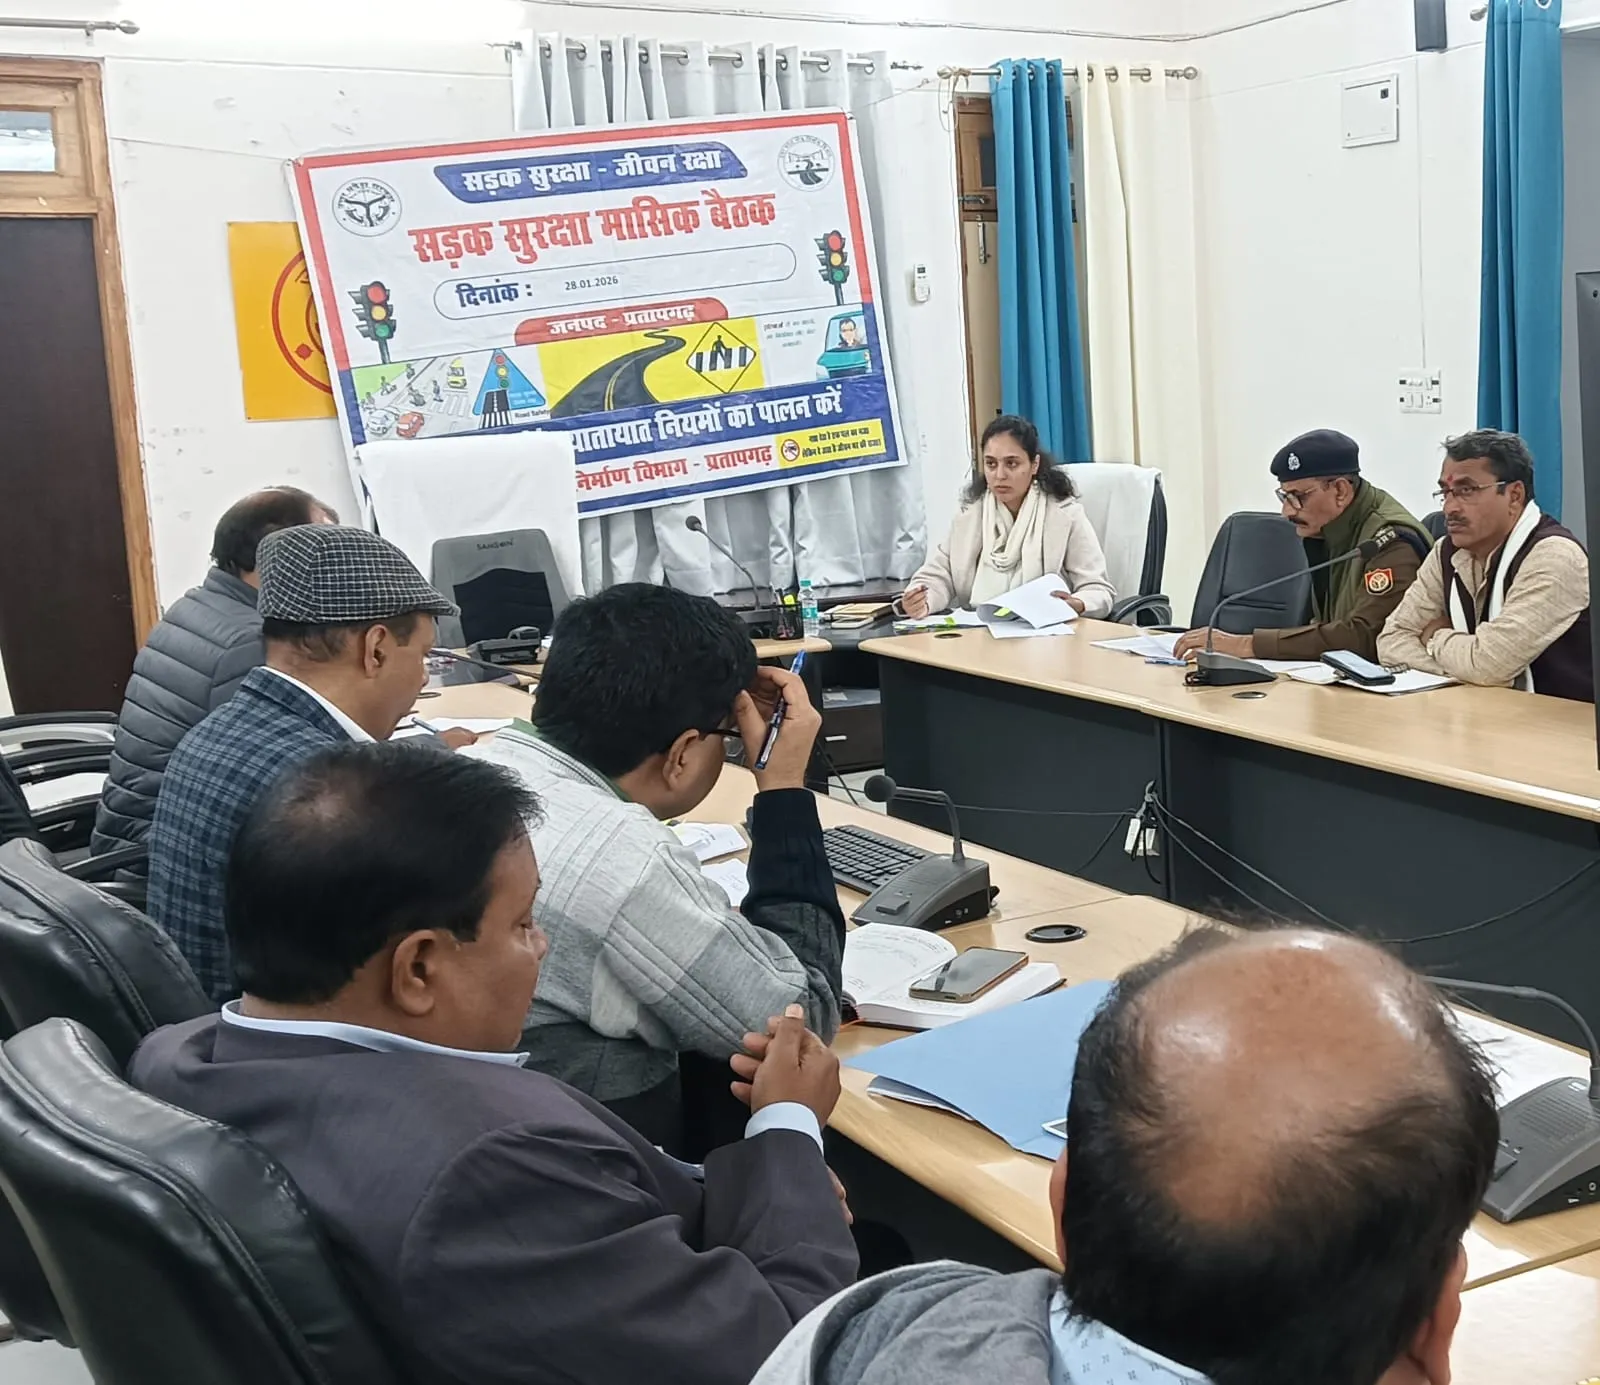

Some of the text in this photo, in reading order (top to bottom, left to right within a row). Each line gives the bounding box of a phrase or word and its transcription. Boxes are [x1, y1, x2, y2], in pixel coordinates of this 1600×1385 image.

[462, 167, 521, 195] सड़क
[527, 161, 591, 192] सुरक्षा
[612, 153, 676, 178] जीवन
[681, 149, 723, 170] रक्षा
[407, 188, 776, 268] सड़क सुरक्षा मासिक बैठक
[456, 279, 519, 308] दिनांक
[564, 275, 619, 290] 28.01.2026
[547, 315, 608, 335] जनपद
[622, 304, 695, 327] प्रतापगढ़
[654, 402, 724, 441] नियमों
[723, 403, 754, 429] का
[755, 392, 812, 424] पालन
[812, 384, 843, 415] करें
[704, 445, 773, 472] प्रतापगढ़
